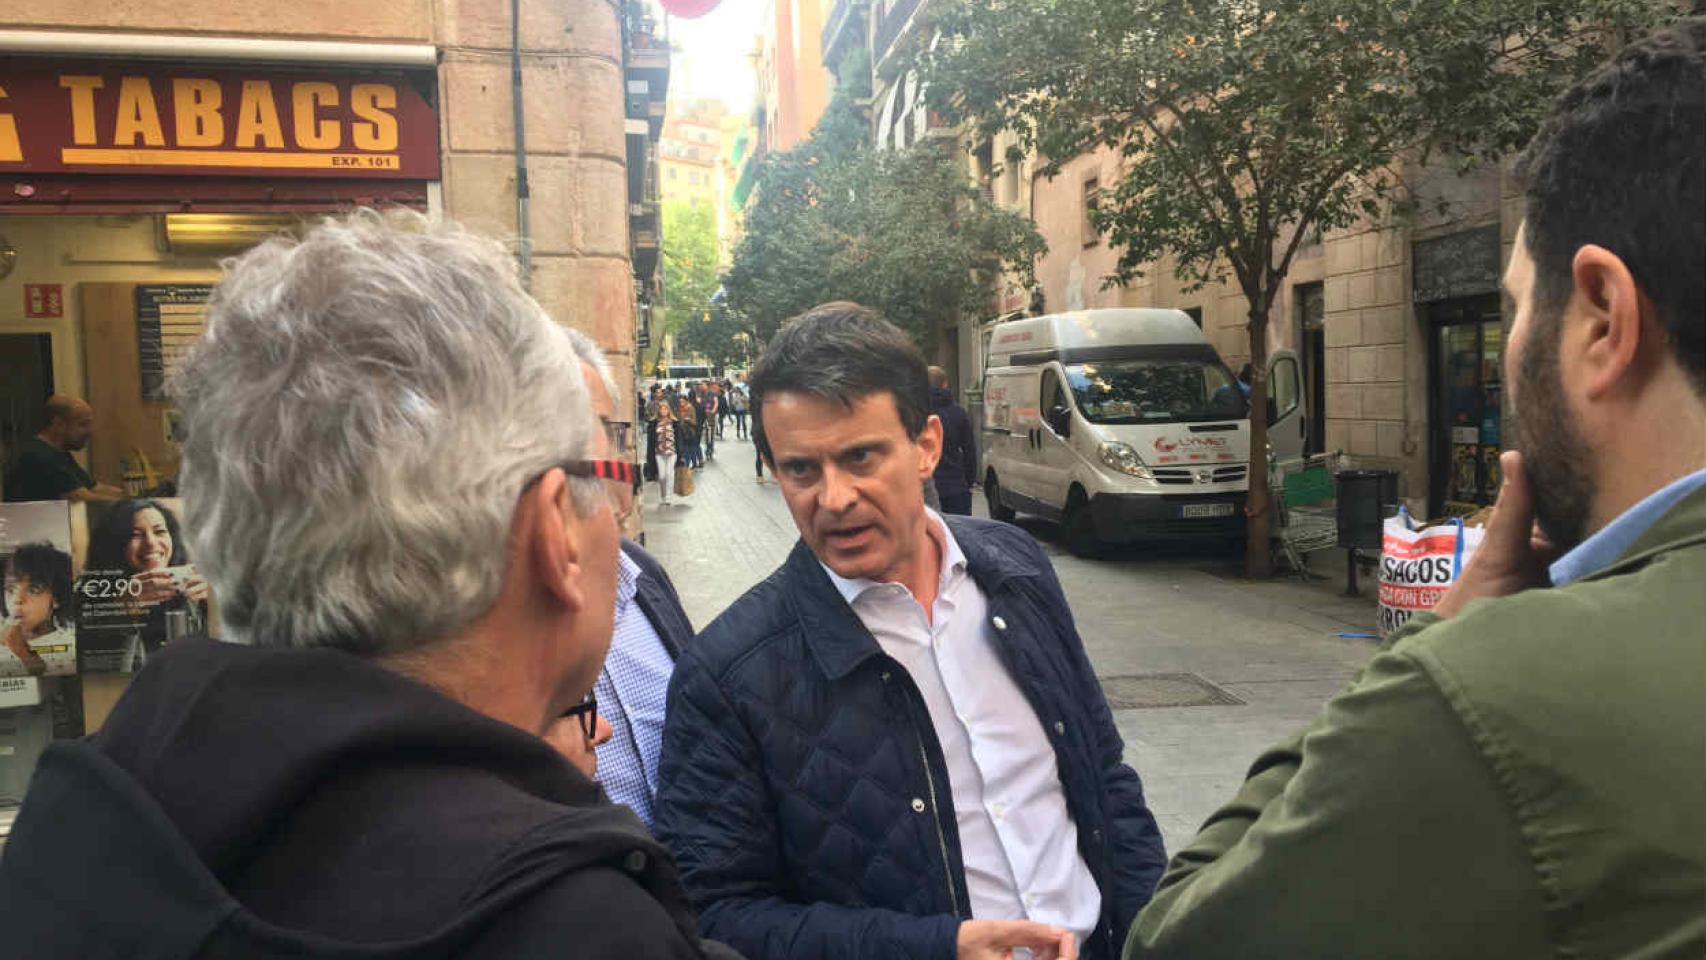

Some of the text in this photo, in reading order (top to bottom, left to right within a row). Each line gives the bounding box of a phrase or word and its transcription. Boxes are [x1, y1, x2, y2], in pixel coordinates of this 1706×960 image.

[59, 75, 398, 150] TABACS
[331, 156, 391, 167] EXP. 101
[1384, 557, 1451, 583] SACOS
[82, 578, 143, 598] €2.90
